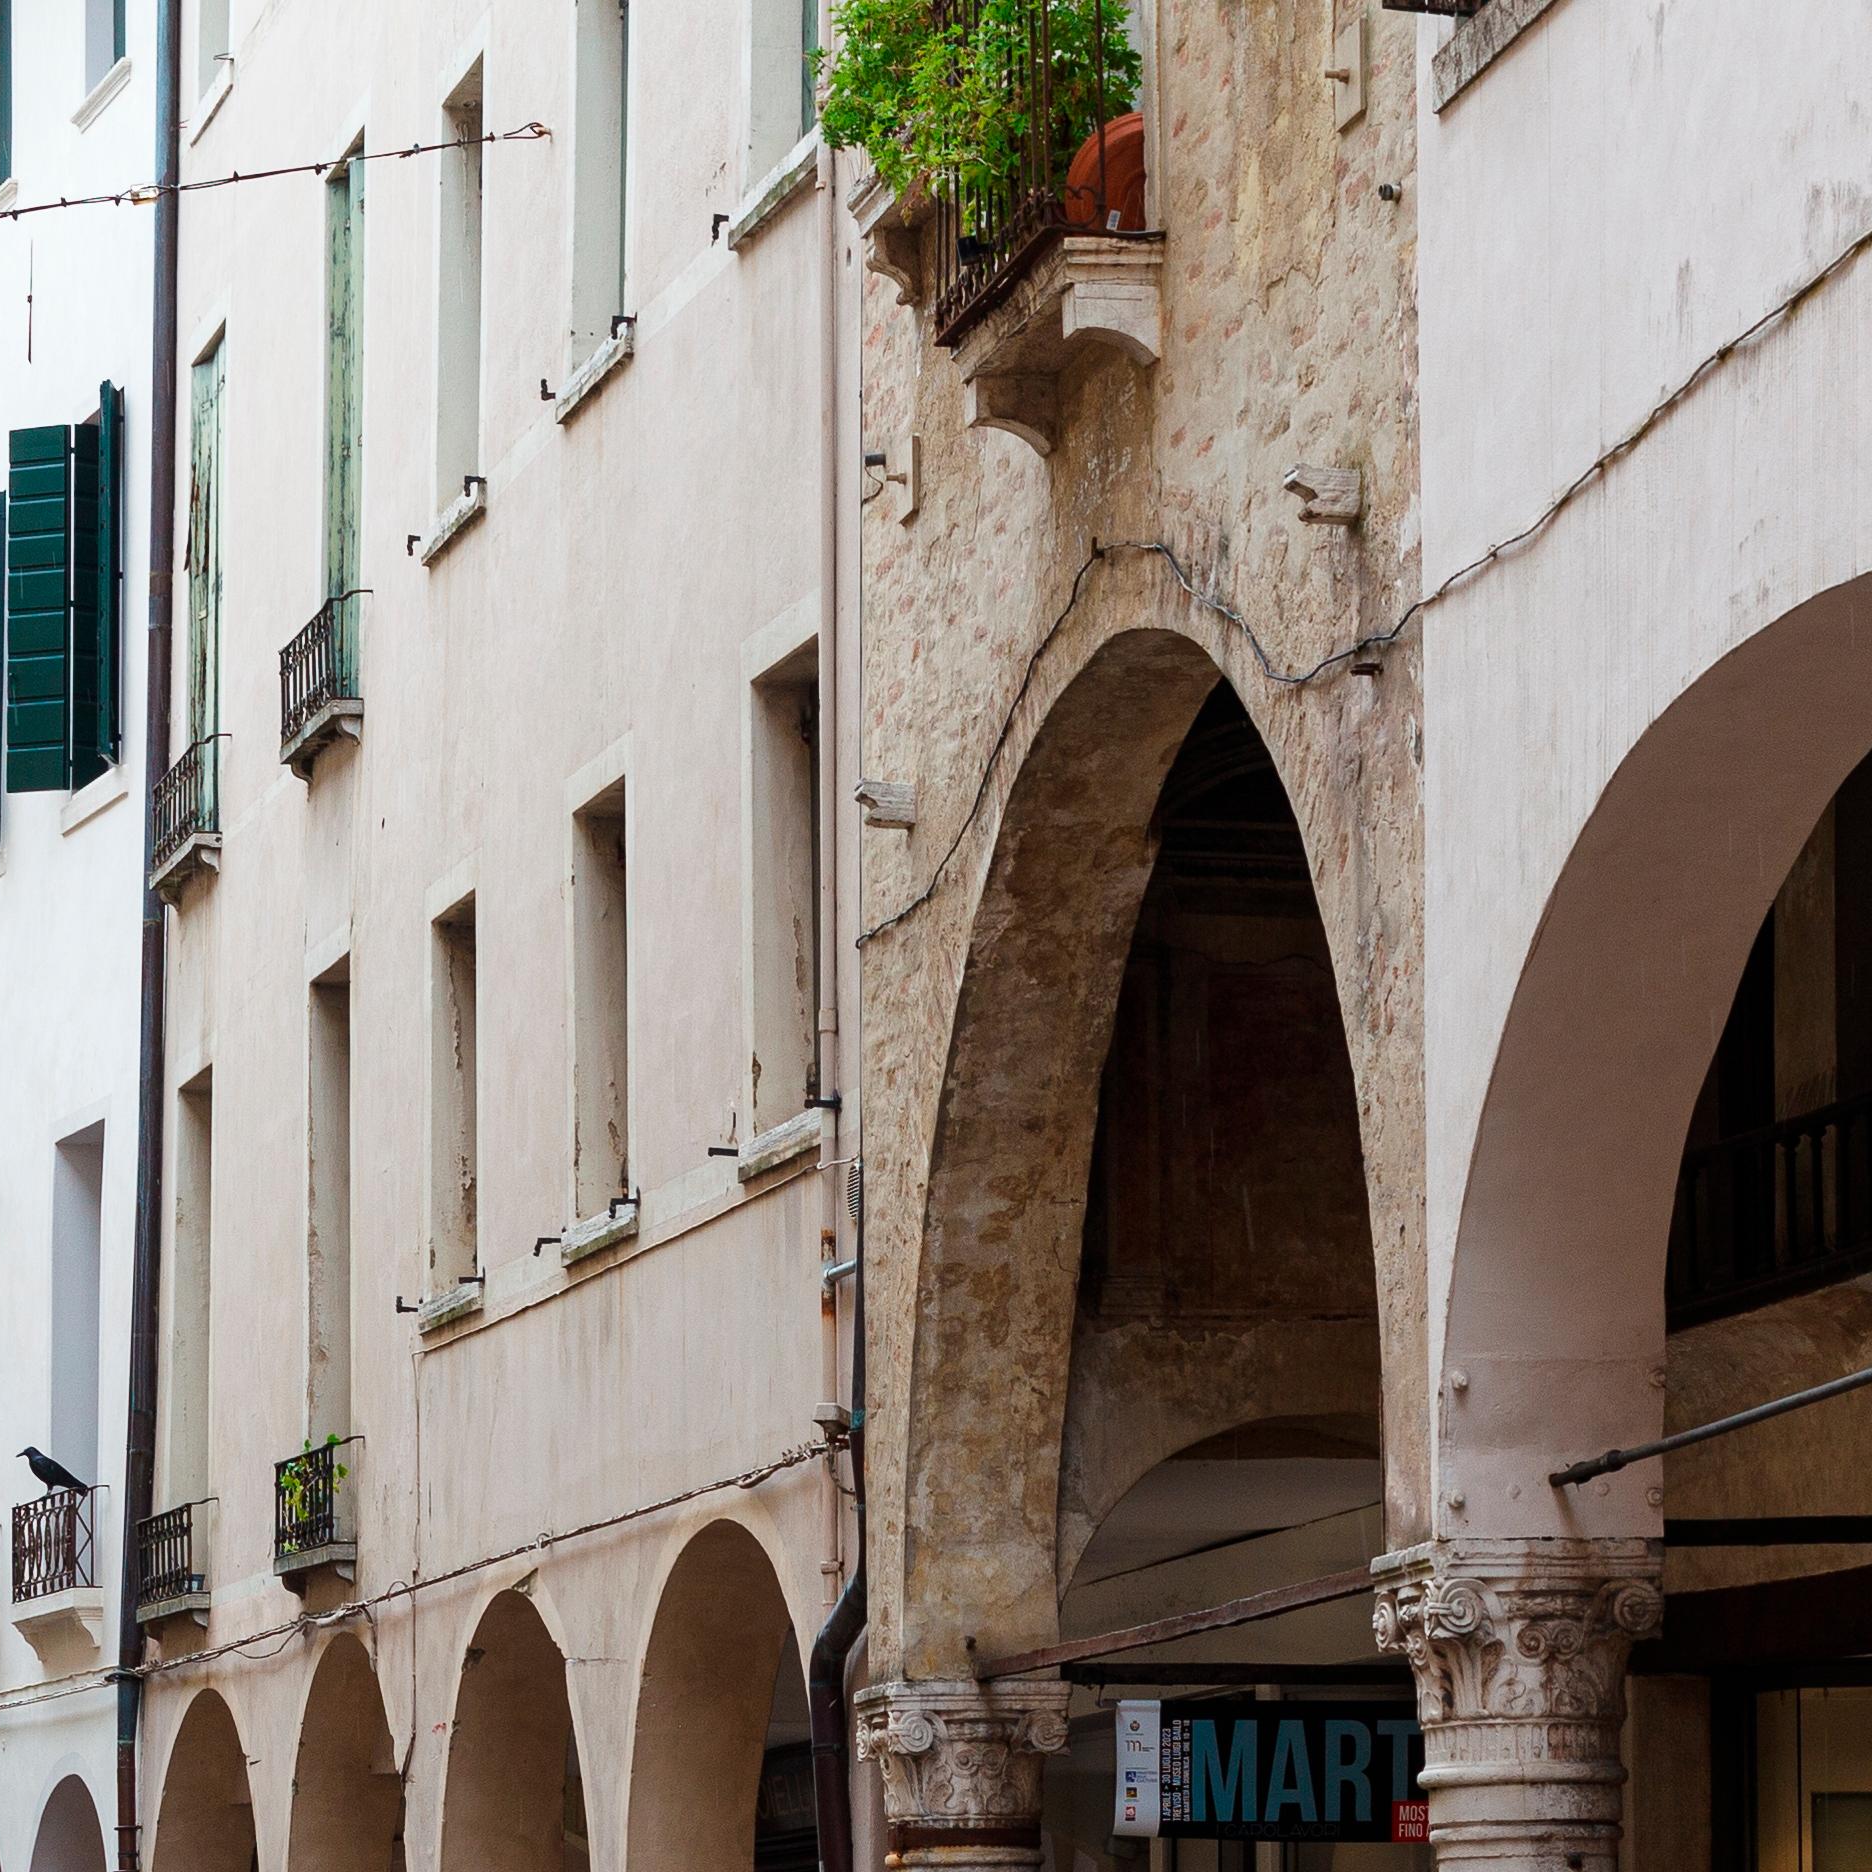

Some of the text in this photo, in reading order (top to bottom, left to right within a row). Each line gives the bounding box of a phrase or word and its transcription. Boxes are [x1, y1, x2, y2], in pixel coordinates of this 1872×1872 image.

[1162, 1728, 1171, 1747] 2023
[1162, 1748, 1171, 1773] LUGLIO
[1172, 1719, 1182, 1821] TREVISO MUSEO LUIGI BAILO
[1191, 1719, 1424, 1822] MART
[1162, 1791, 1171, 1817] APRILE
[1398, 1823, 1423, 1838] FINO
